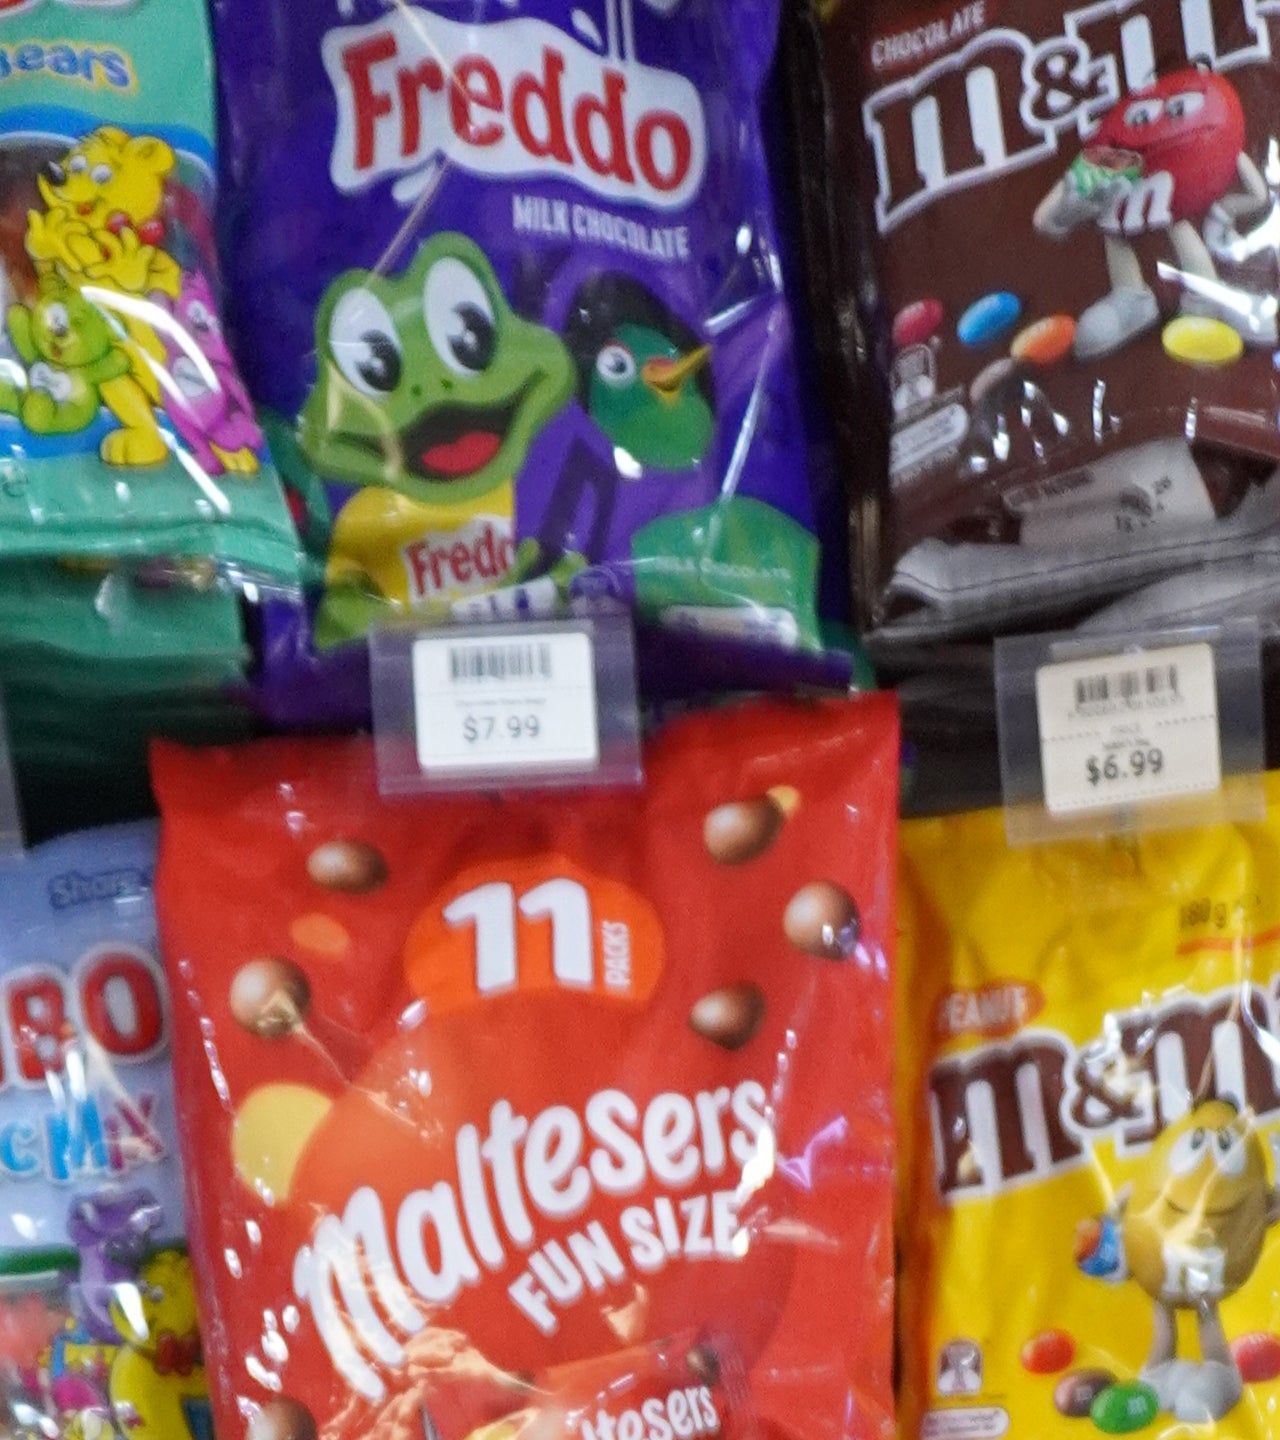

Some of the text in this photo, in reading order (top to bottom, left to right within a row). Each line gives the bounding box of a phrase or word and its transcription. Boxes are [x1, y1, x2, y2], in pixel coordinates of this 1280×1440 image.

[870, 0, 988, 67] CHOCOLATE
[340, 28, 693, 195] Freddo
[512, 195, 690, 259] MILK CHOCOLATE
[462, 714, 541, 743] $7.99
[1086, 747, 1164, 787] $6.99
[442, 876, 595, 998] 11
[601, 918, 633, 989] PACKS
[290, 1078, 777, 1402] Maltesers
[508, 1191, 750, 1336] FUN SIZE
